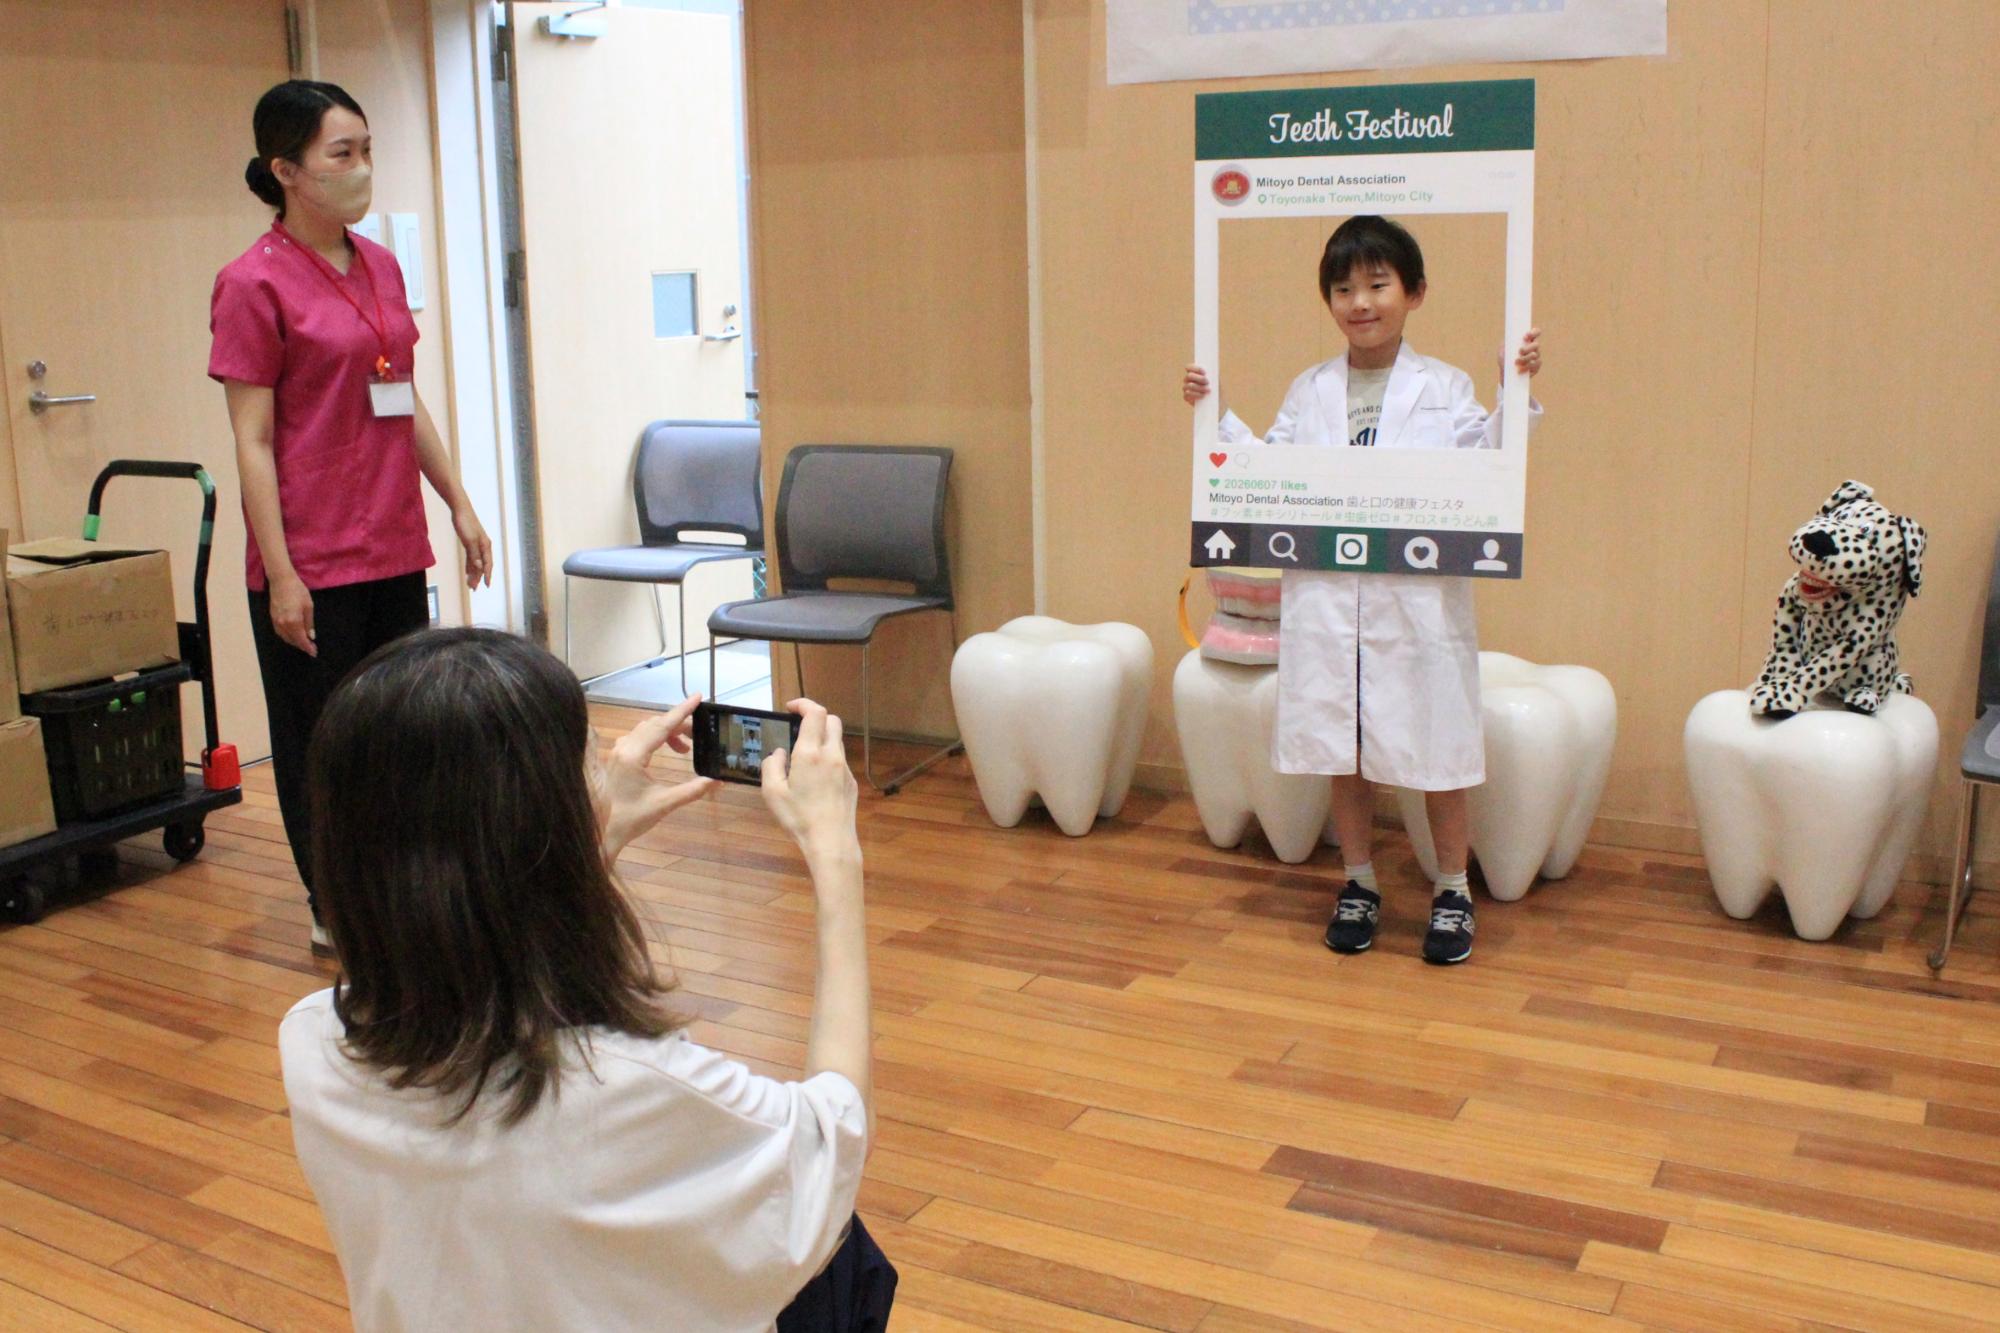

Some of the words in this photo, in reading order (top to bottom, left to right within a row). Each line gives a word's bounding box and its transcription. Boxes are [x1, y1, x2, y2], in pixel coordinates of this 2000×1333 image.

[1269, 108, 1342, 143] Teeth
[1345, 103, 1454, 140] Festival
[1256, 177, 1294, 189] Mitoyo
[1297, 176, 1334, 187] Dental
[1337, 174, 1406, 185] Association
[1270, 193, 1325, 206] Toyonaka
[1409, 190, 1433, 203] City
[1224, 479, 1277, 490] 20260607
[1281, 480, 1308, 491] likes
[1209, 492, 1243, 505] Mitoyo
[1246, 493, 1279, 504] Dental
[1282, 494, 1344, 506] Association
[1347, 496, 1465, 511] 歯と口の健康フェスタ
